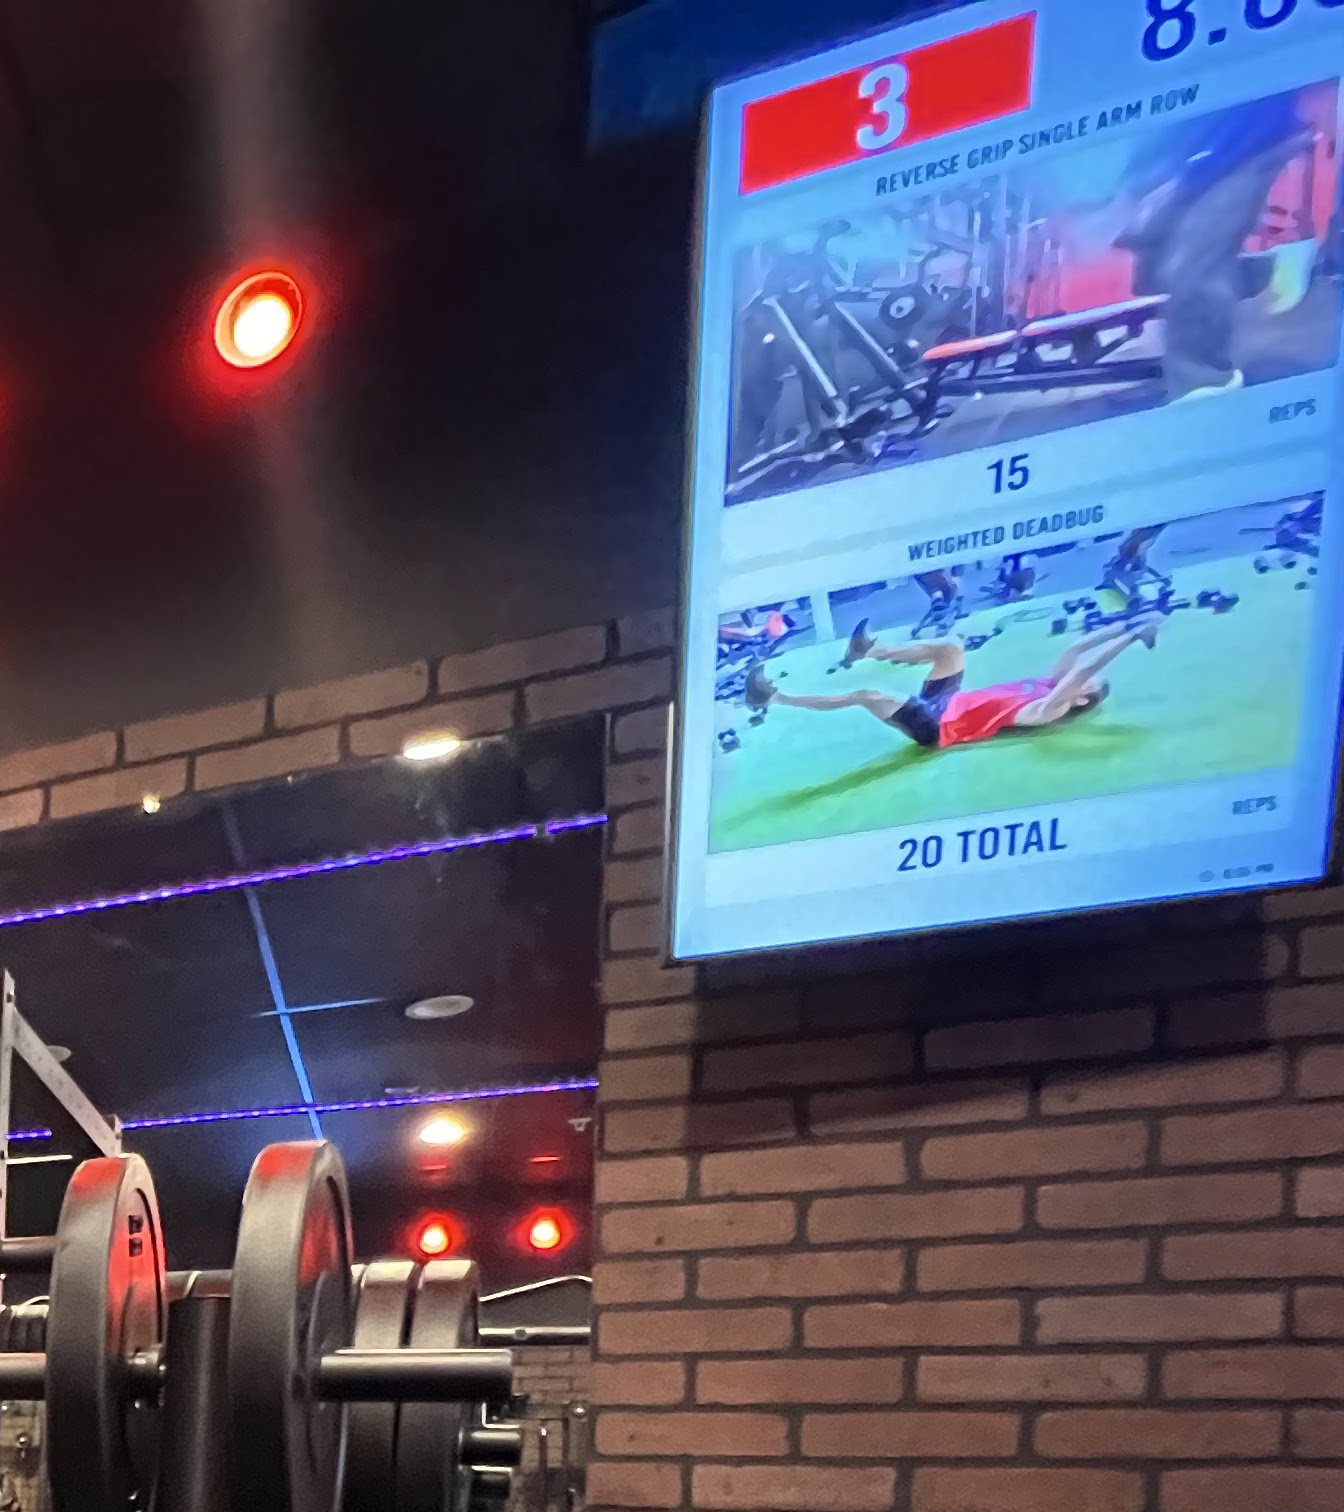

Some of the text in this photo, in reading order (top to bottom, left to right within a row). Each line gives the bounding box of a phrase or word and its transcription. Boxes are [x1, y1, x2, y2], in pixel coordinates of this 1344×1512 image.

[855, 62, 909, 151] 3
[875, 83, 1200, 197] REVERSE GRIP SINGLE ARM ROW
[986, 453, 1030, 494] 15
[907, 504, 1105, 562] WEIGHTED DEADBUG
[896, 817, 1068, 872] 20 TOTAL
